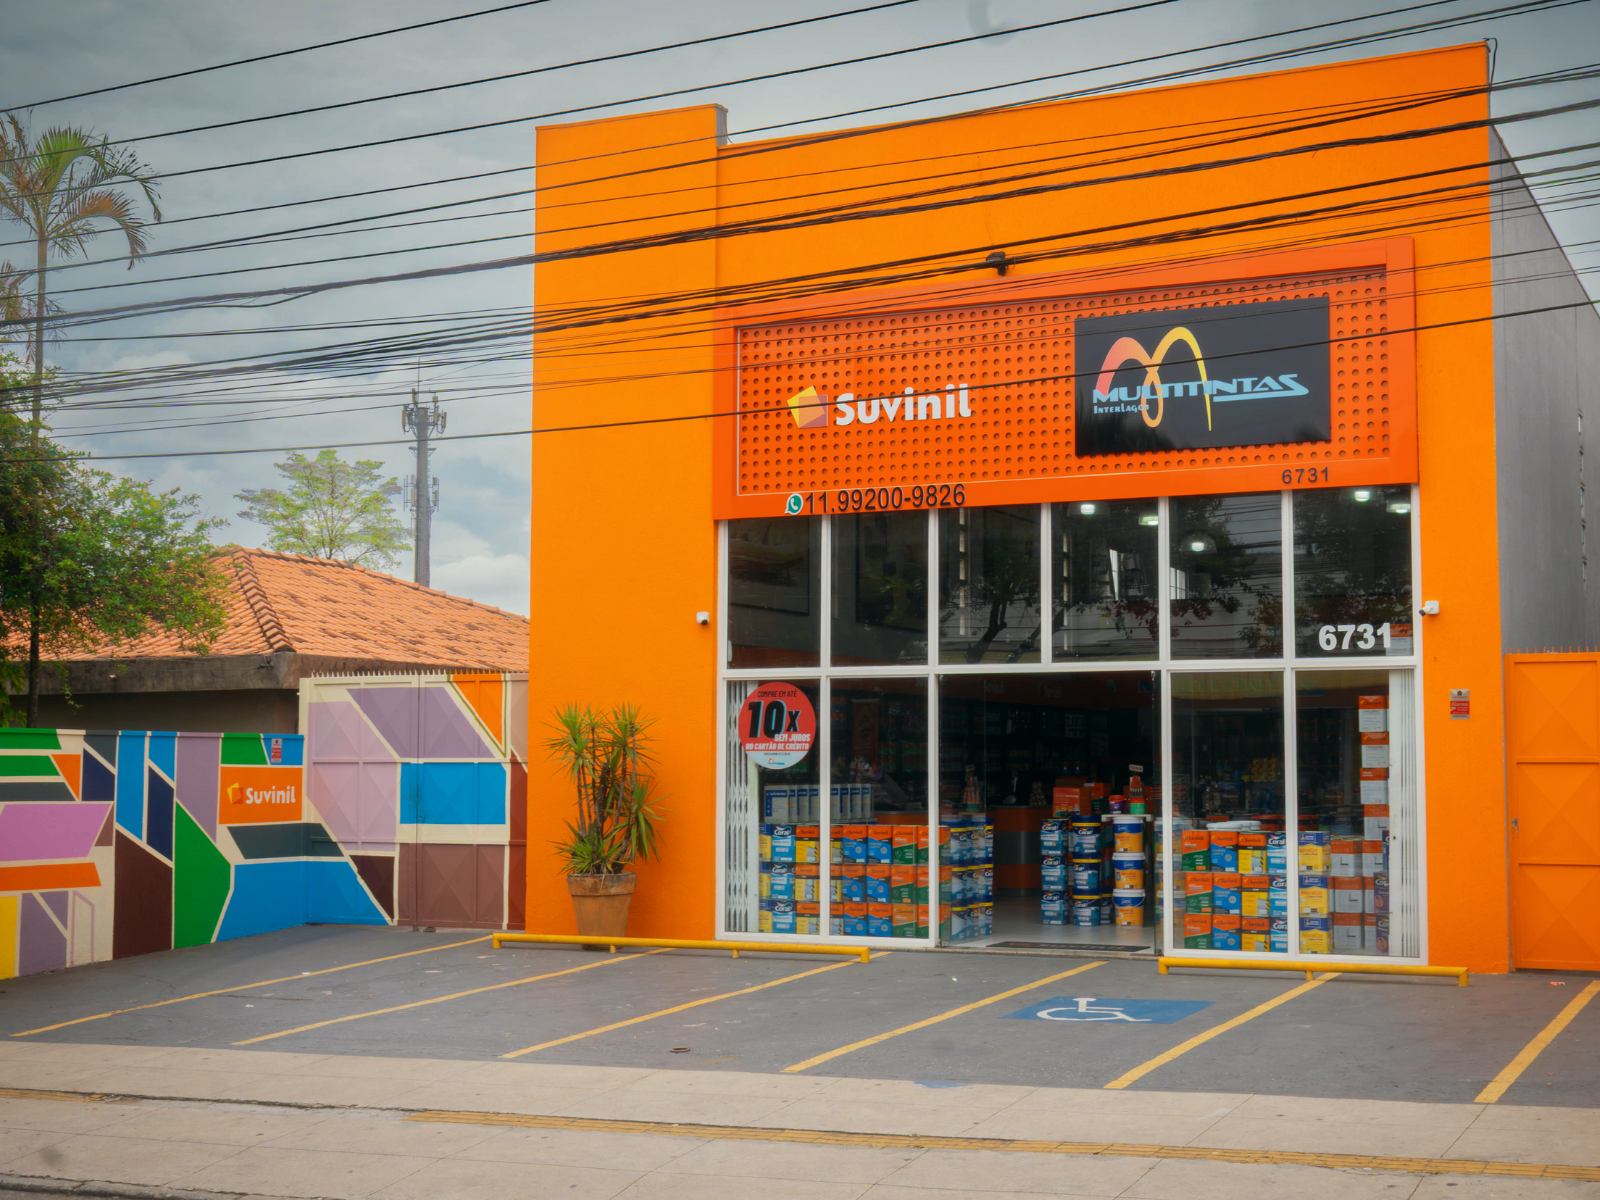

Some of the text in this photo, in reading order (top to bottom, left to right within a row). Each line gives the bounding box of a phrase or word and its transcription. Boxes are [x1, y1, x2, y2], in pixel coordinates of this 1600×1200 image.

[1093, 373, 1309, 403] MULTITINTAS
[836, 383, 972, 426] Suvinil
[1282, 467, 1329, 484] 6731
[805, 483, 966, 514] 11.99200-9826
[1318, 623, 1391, 650] 6731
[757, 690, 778, 698] COMPRE
[786, 689, 798, 697] ATÉ
[745, 741, 809, 750] NO CARTÃO DE CRÉDITO
[774, 733, 811, 742] SEM JUROS
[246, 785, 296, 805] Suvinil
